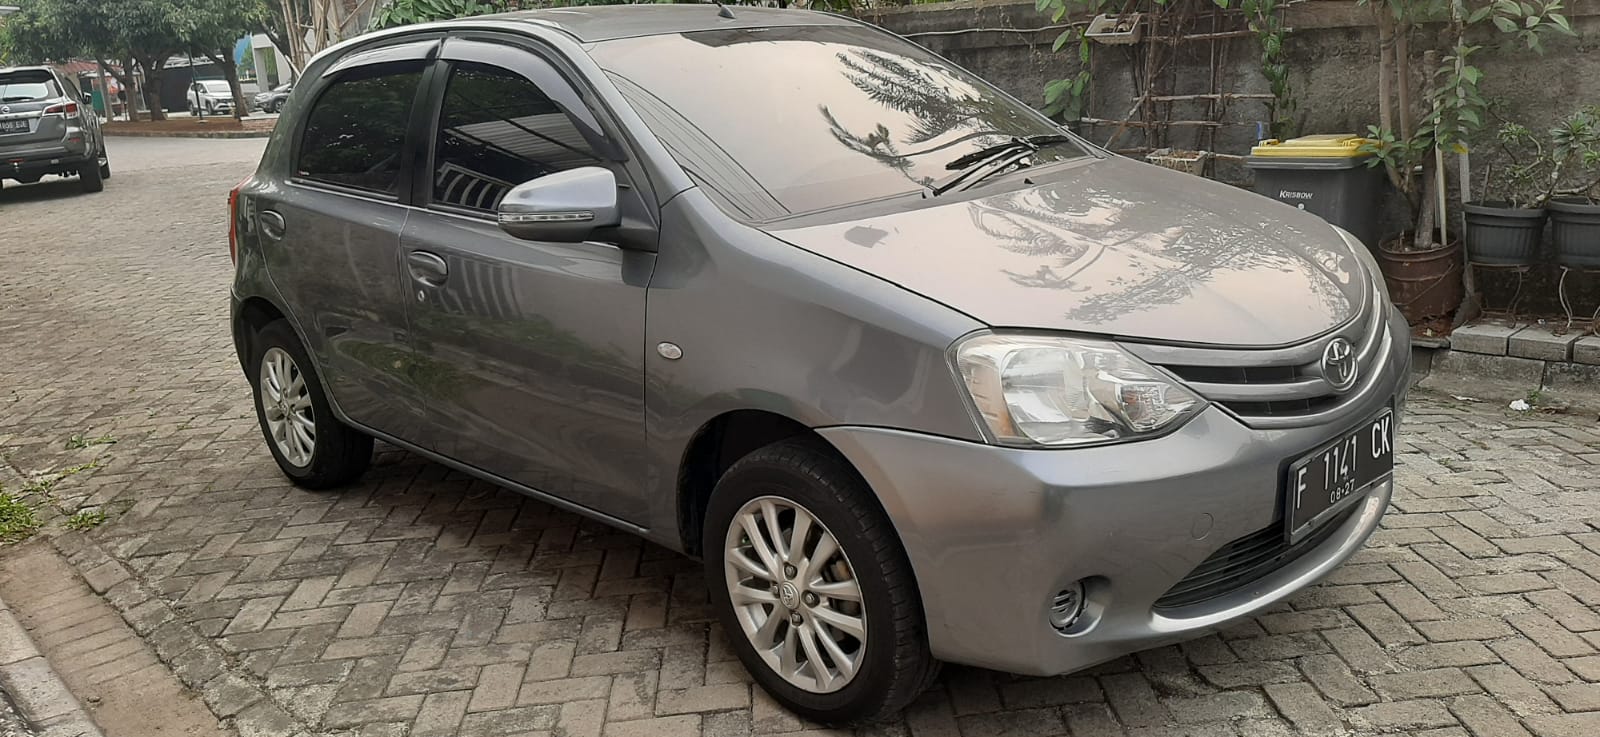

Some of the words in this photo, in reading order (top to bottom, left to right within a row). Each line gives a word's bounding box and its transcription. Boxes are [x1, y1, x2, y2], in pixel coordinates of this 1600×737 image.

[1297, 466, 1308, 510] F
[1324, 435, 1357, 490] 1141
[1372, 416, 1390, 458] CK
